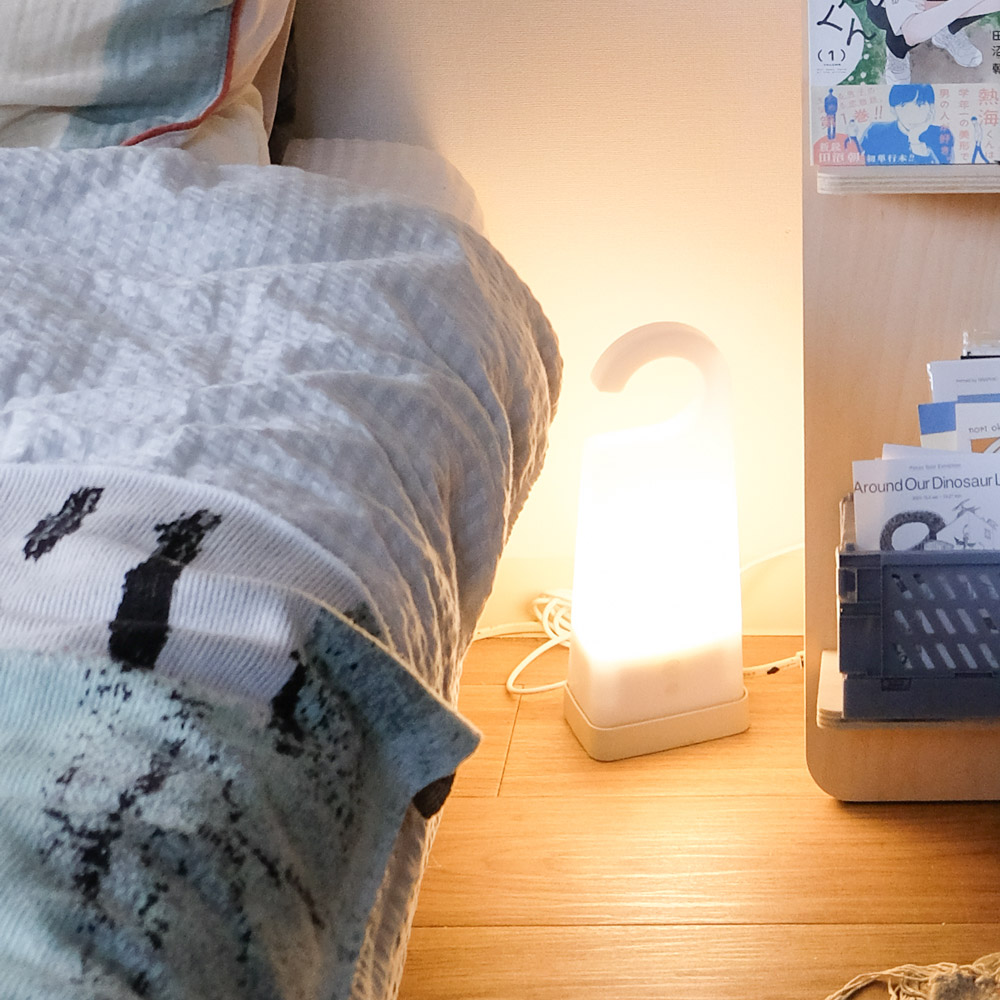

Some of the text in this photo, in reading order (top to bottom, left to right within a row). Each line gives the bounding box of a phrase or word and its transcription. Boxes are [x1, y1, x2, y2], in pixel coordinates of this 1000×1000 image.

[958, 88, 970, 161] 学年一の美形で
[978, 88, 1000, 160] 熱海くんは
[854, 478, 903, 494] Around
[904, 476, 930, 491] Our
[932, 475, 993, 490] Dinosaur
